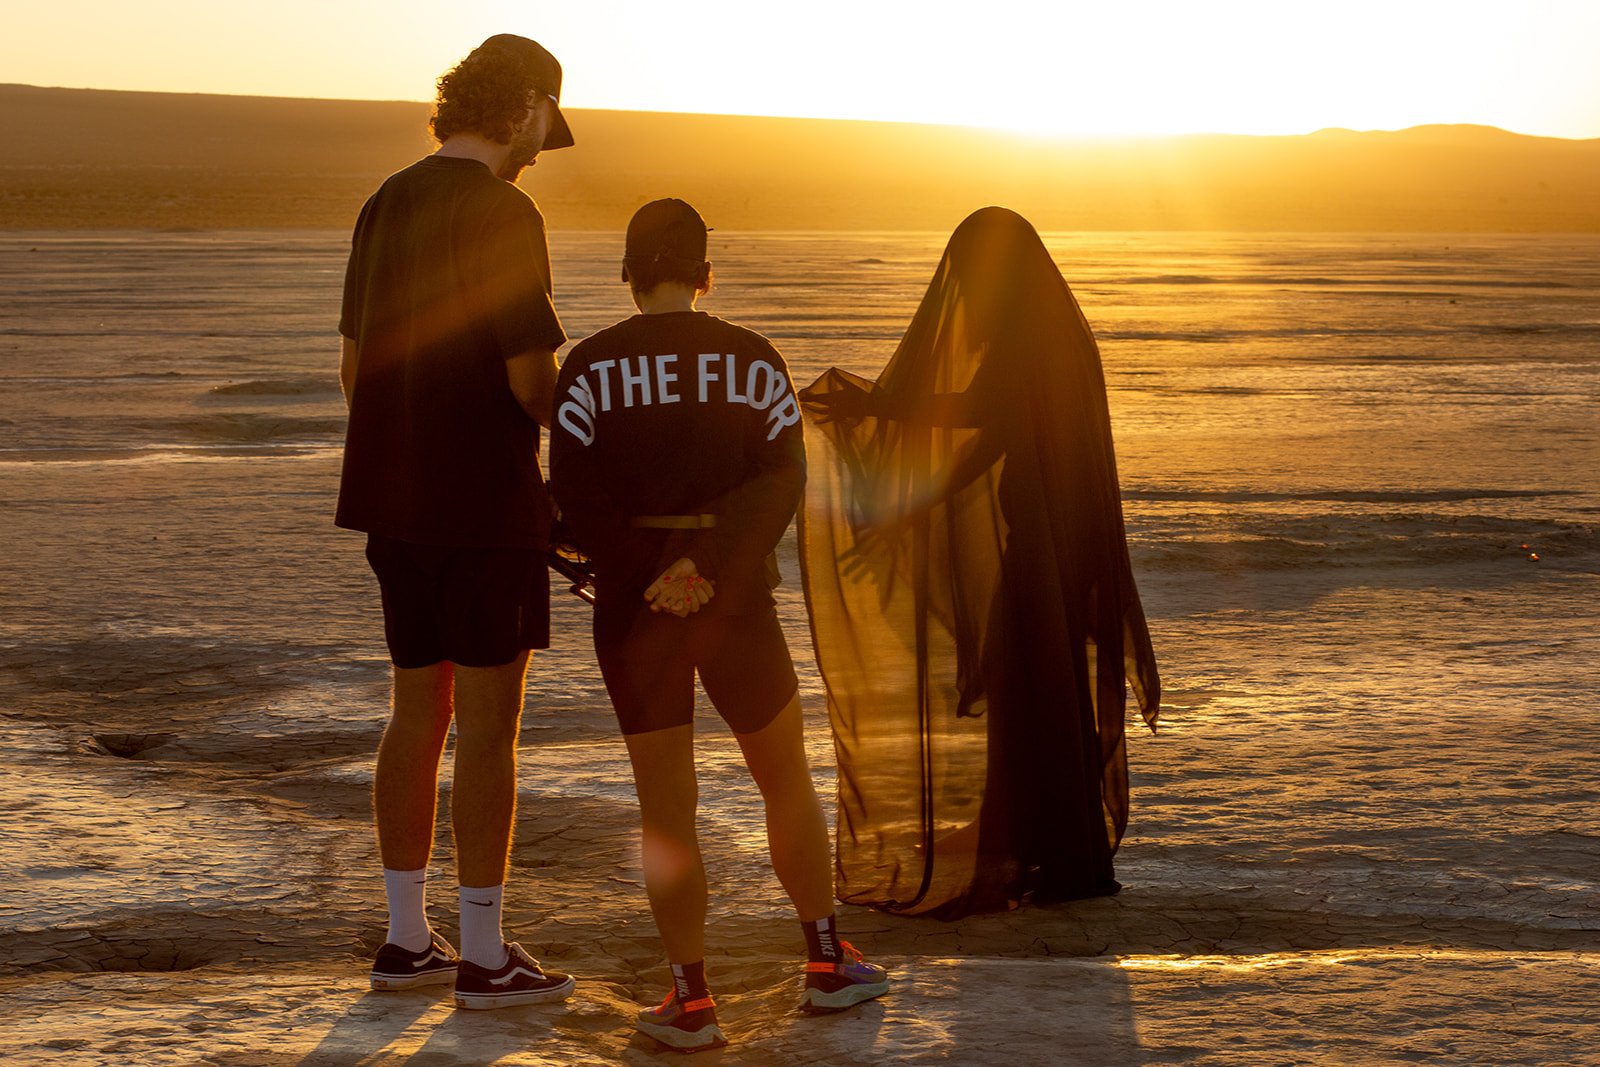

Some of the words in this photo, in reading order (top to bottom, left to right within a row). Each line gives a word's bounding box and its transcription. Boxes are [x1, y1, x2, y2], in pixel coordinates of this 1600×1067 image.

[558, 374, 596, 446] ON
[589, 354, 681, 412] THE
[817, 933, 836, 957] NIKE
